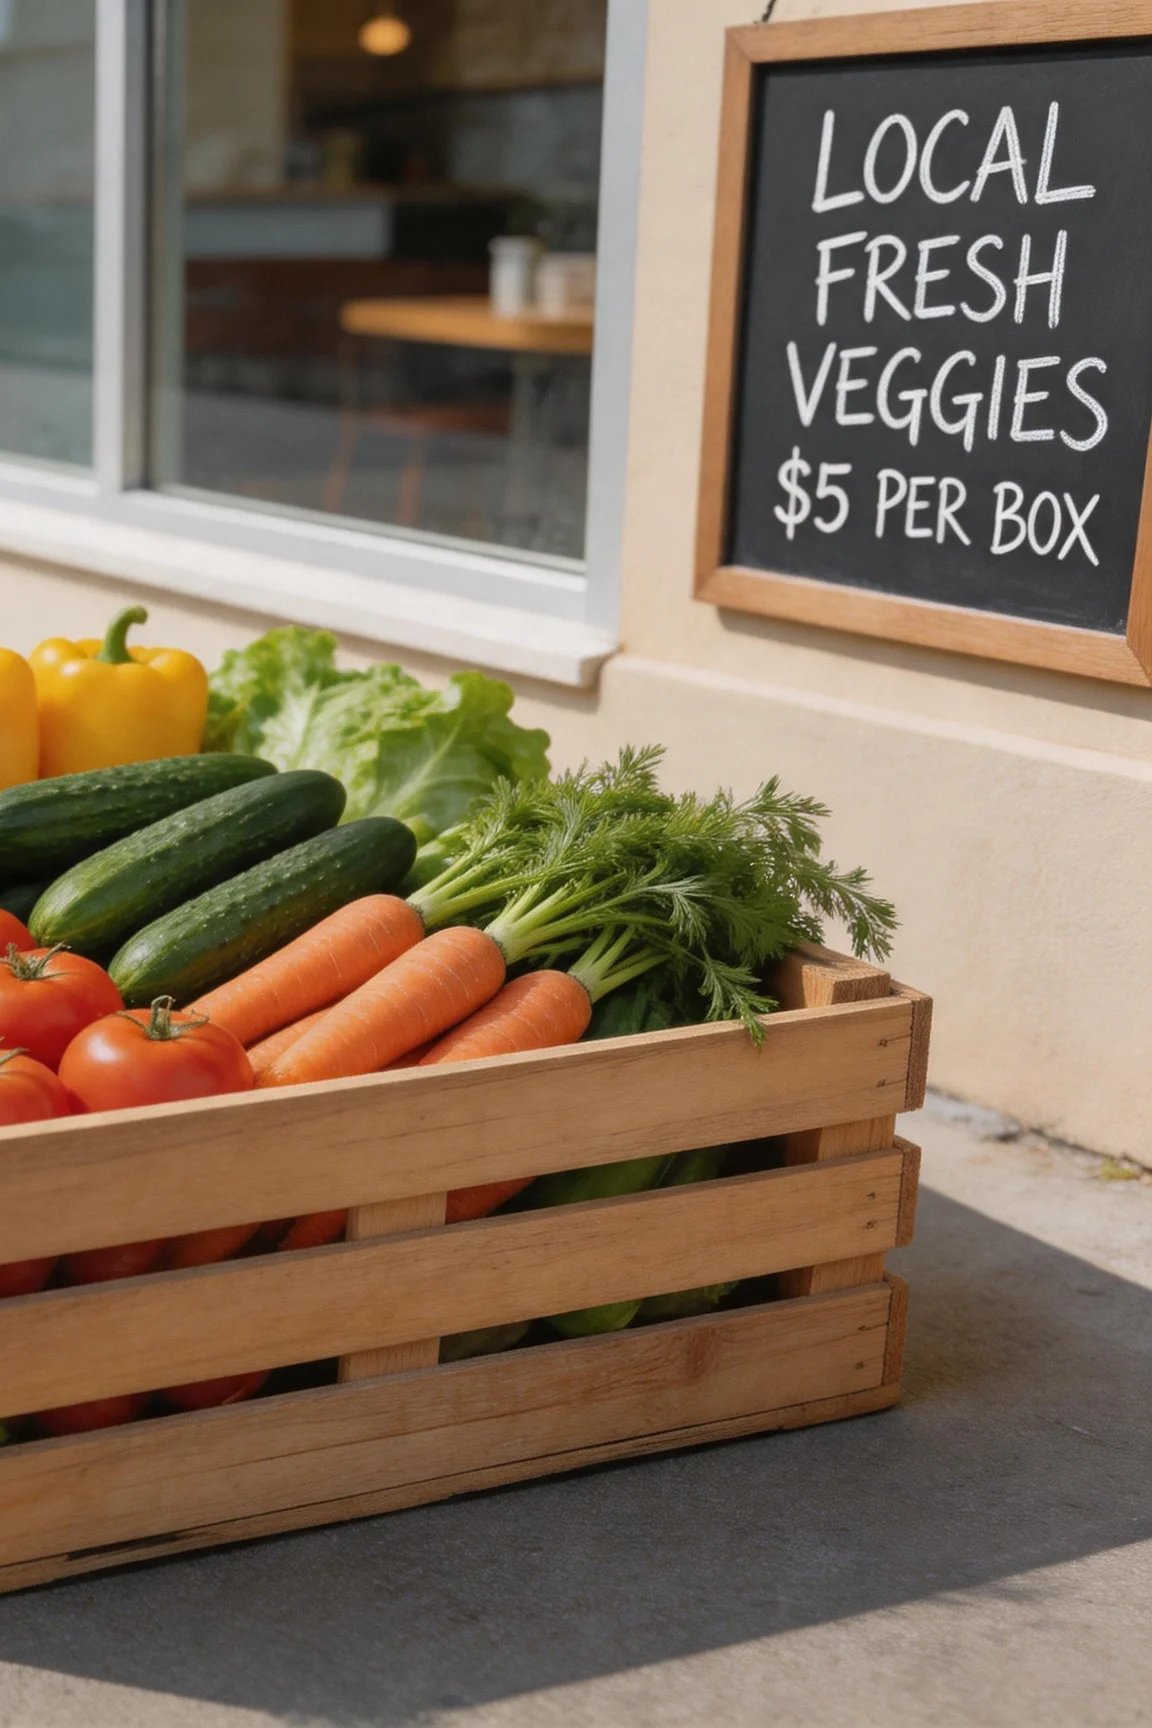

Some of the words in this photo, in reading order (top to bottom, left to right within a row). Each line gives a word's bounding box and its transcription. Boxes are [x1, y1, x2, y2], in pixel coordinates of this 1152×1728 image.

[811, 101, 1097, 213] LOCAL
[815, 229, 1068, 329] FRESH
[786, 341, 1109, 453] VEGGIES
[773, 445, 853, 541] $5
[875, 468, 972, 547] PER
[990, 480, 1101, 567] BOX
